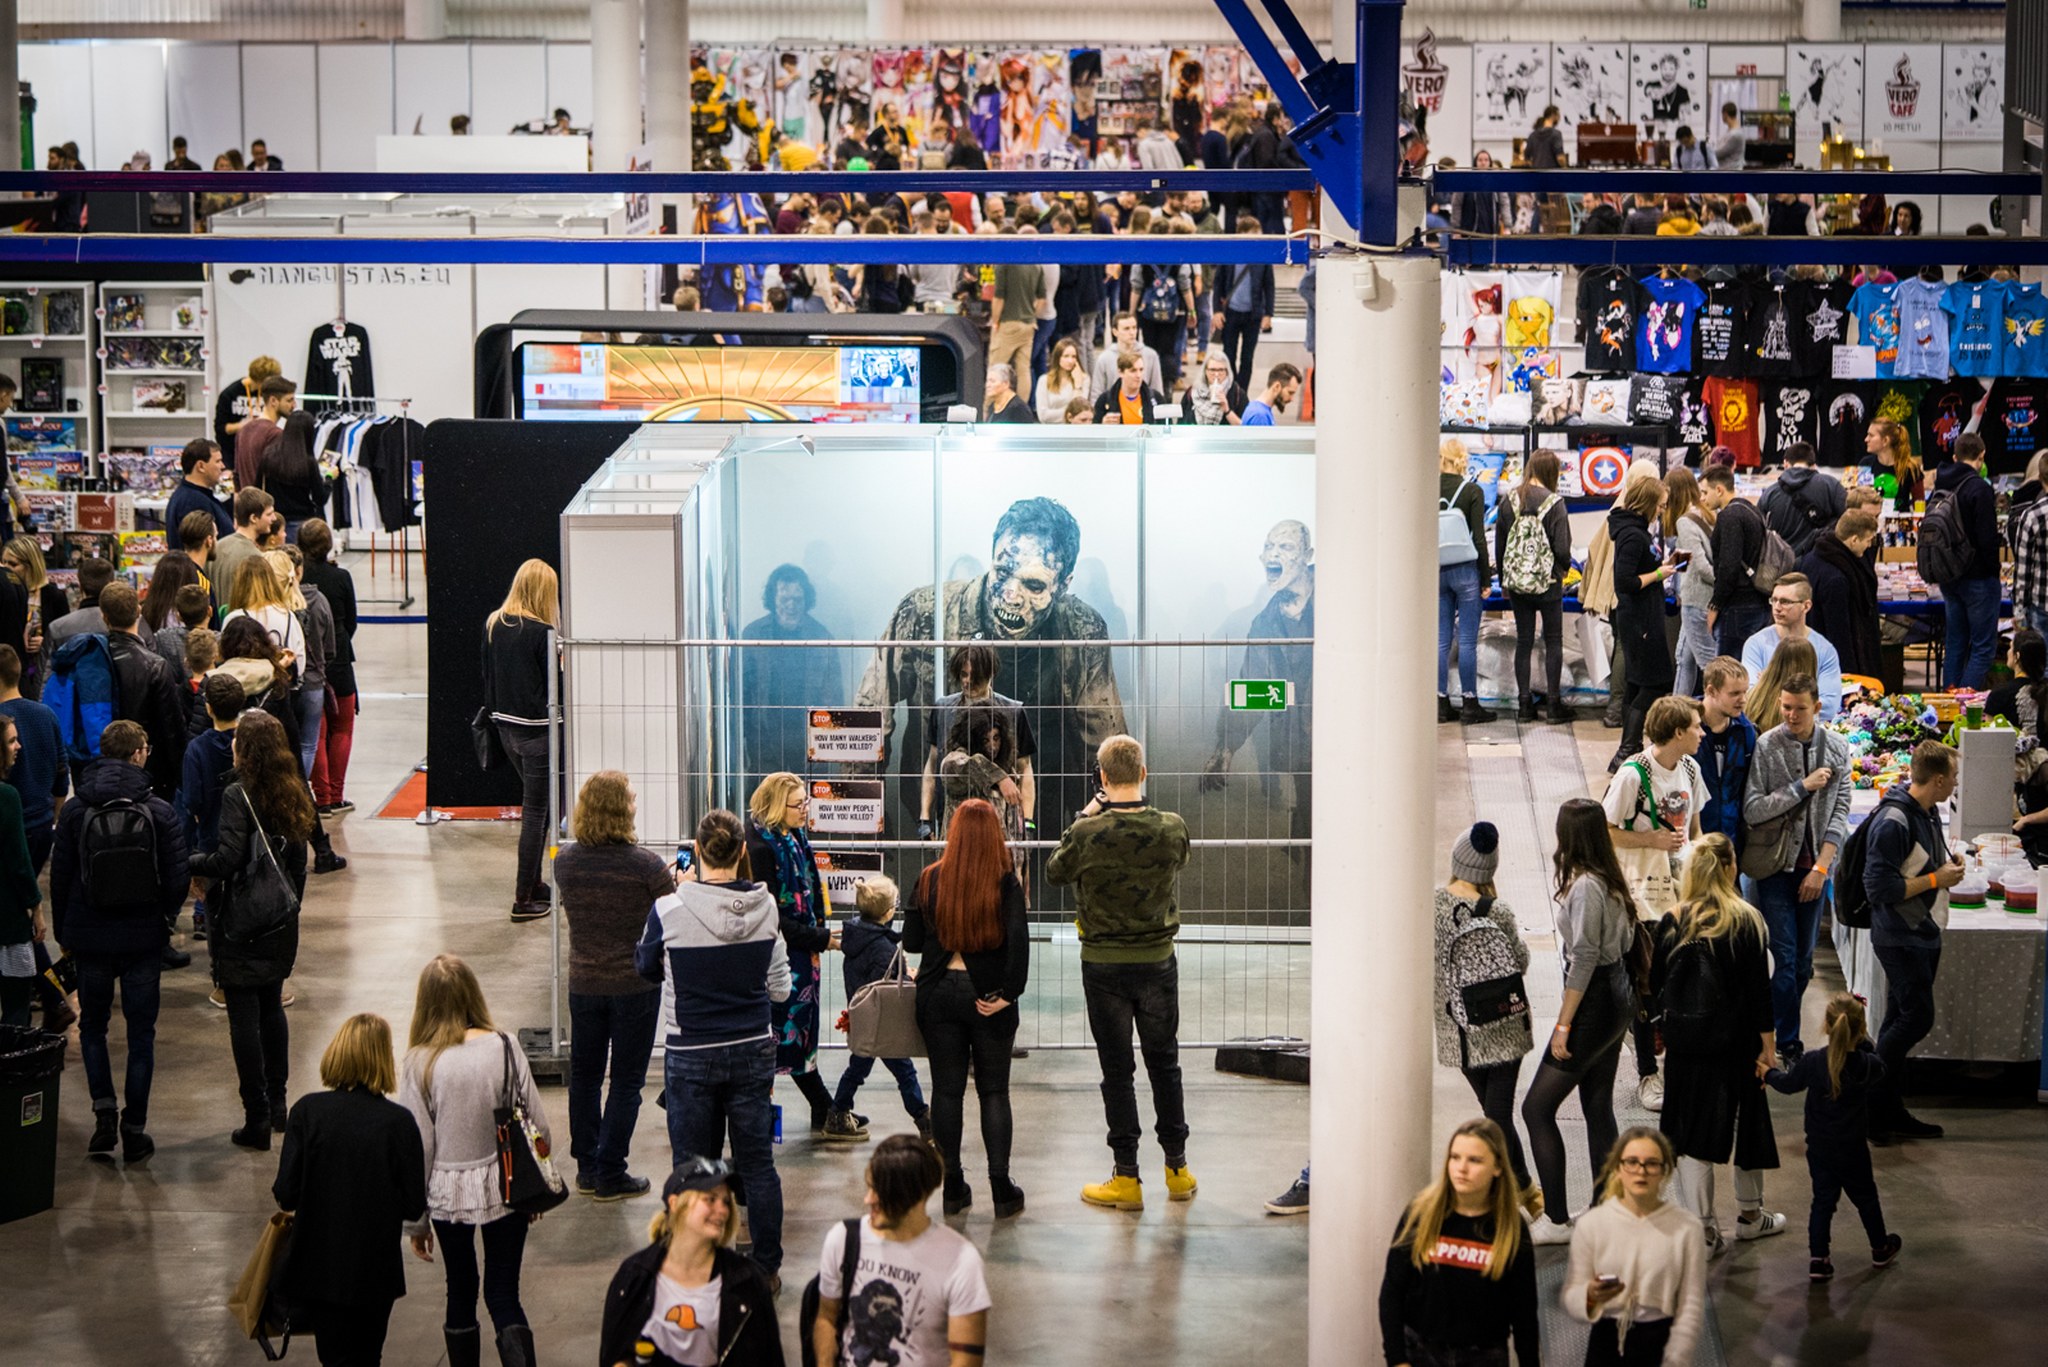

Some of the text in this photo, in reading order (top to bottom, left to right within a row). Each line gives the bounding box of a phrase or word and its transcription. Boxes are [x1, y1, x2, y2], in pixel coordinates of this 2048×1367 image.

[1404, 74, 1445, 94] VERO
[1888, 89, 1918, 102] VERO
[1889, 104, 1915, 117] CAFE
[323, 335, 358, 349] STAR
[813, 715, 831, 723] STOP
[814, 734, 828, 742] HOW
[829, 734, 847, 742] MANY
[813, 786, 831, 794] STOP
[819, 804, 875, 812] HOW MANY PEOPLE
[857, 1258, 921, 1285] OU KNOW
